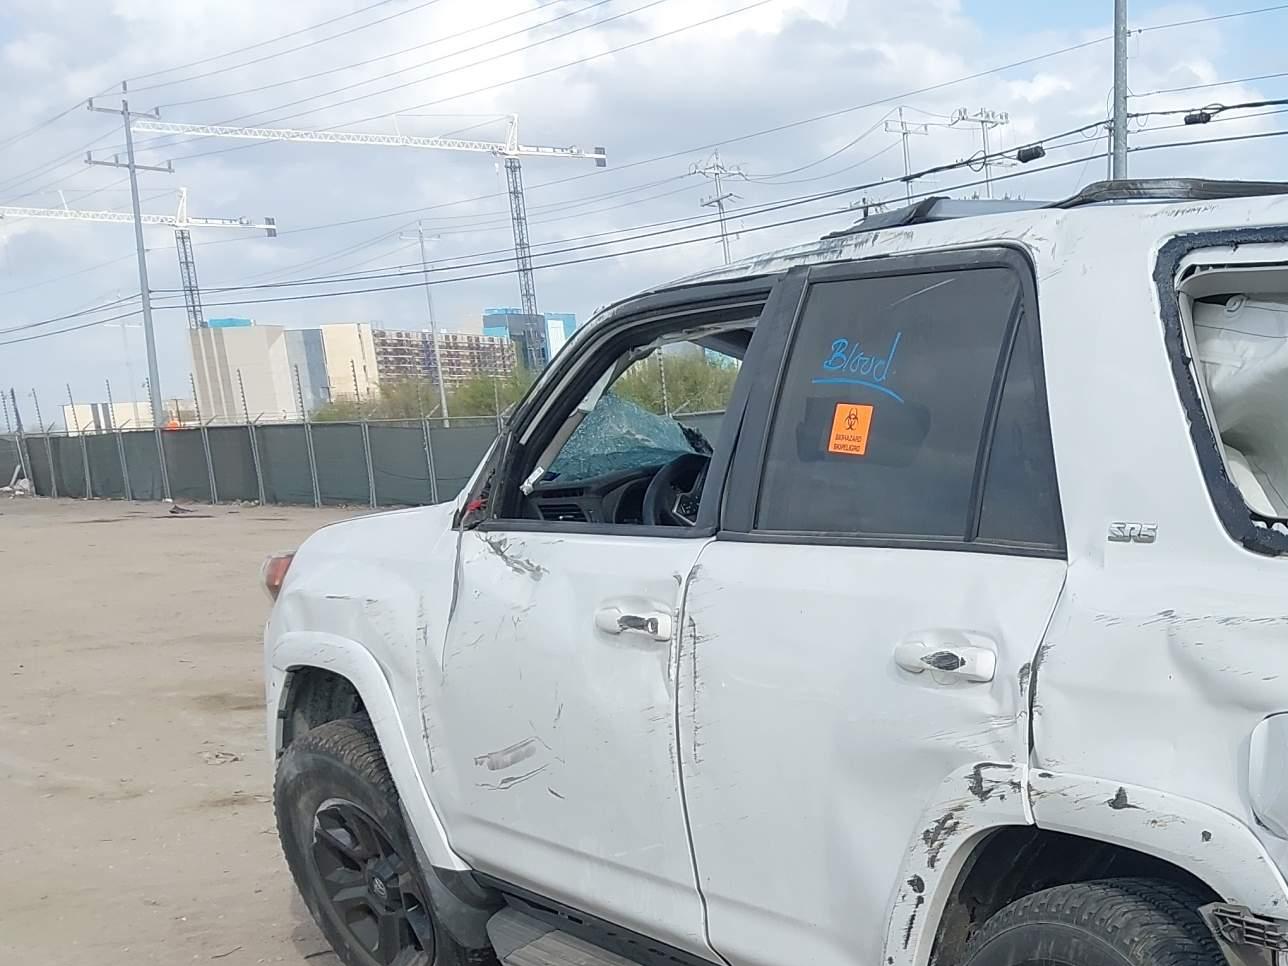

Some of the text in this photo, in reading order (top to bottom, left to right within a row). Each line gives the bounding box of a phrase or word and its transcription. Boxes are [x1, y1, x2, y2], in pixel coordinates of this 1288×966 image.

[824, 332, 902, 382] Blood
[835, 434, 862, 443] BIOHAZARD
[1108, 522, 1158, 543] SR5
